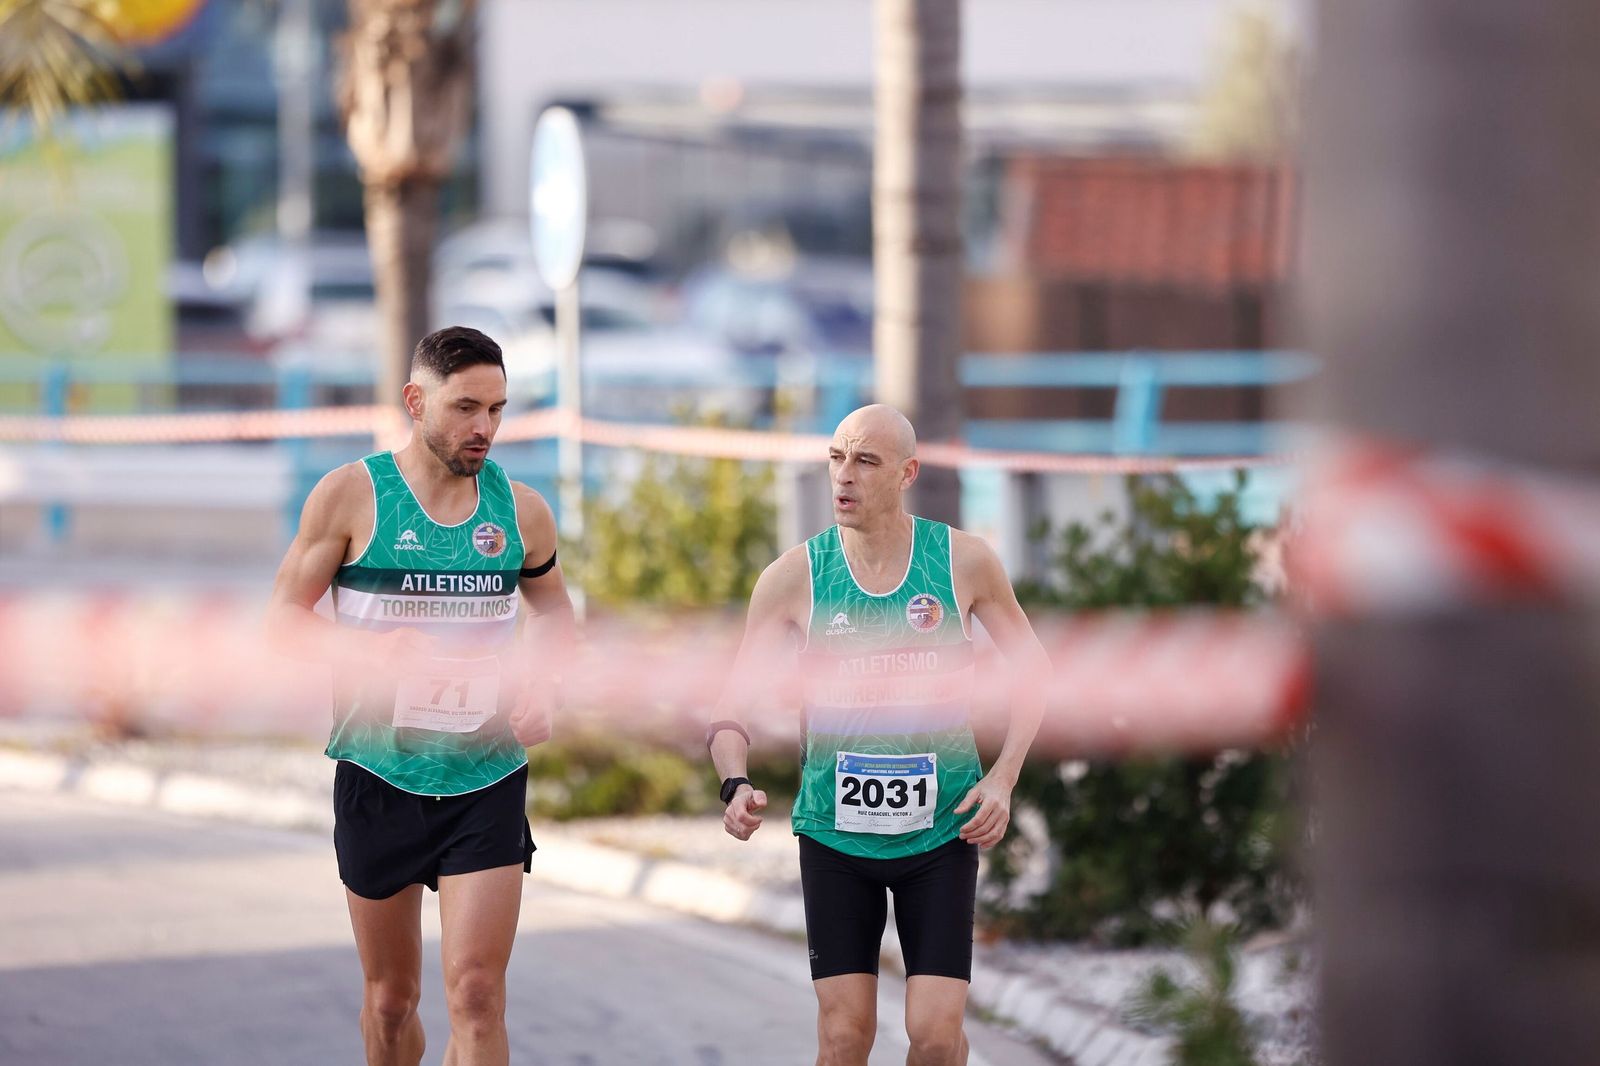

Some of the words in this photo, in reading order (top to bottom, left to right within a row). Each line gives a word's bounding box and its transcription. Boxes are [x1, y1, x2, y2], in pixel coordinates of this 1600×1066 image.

[400, 573, 503, 592] ATLETISMO
[380, 598, 511, 618] TORREMOLINOS
[838, 651, 937, 676] ATLETISMO
[430, 679, 470, 708] 71
[841, 776, 927, 809] 2031
